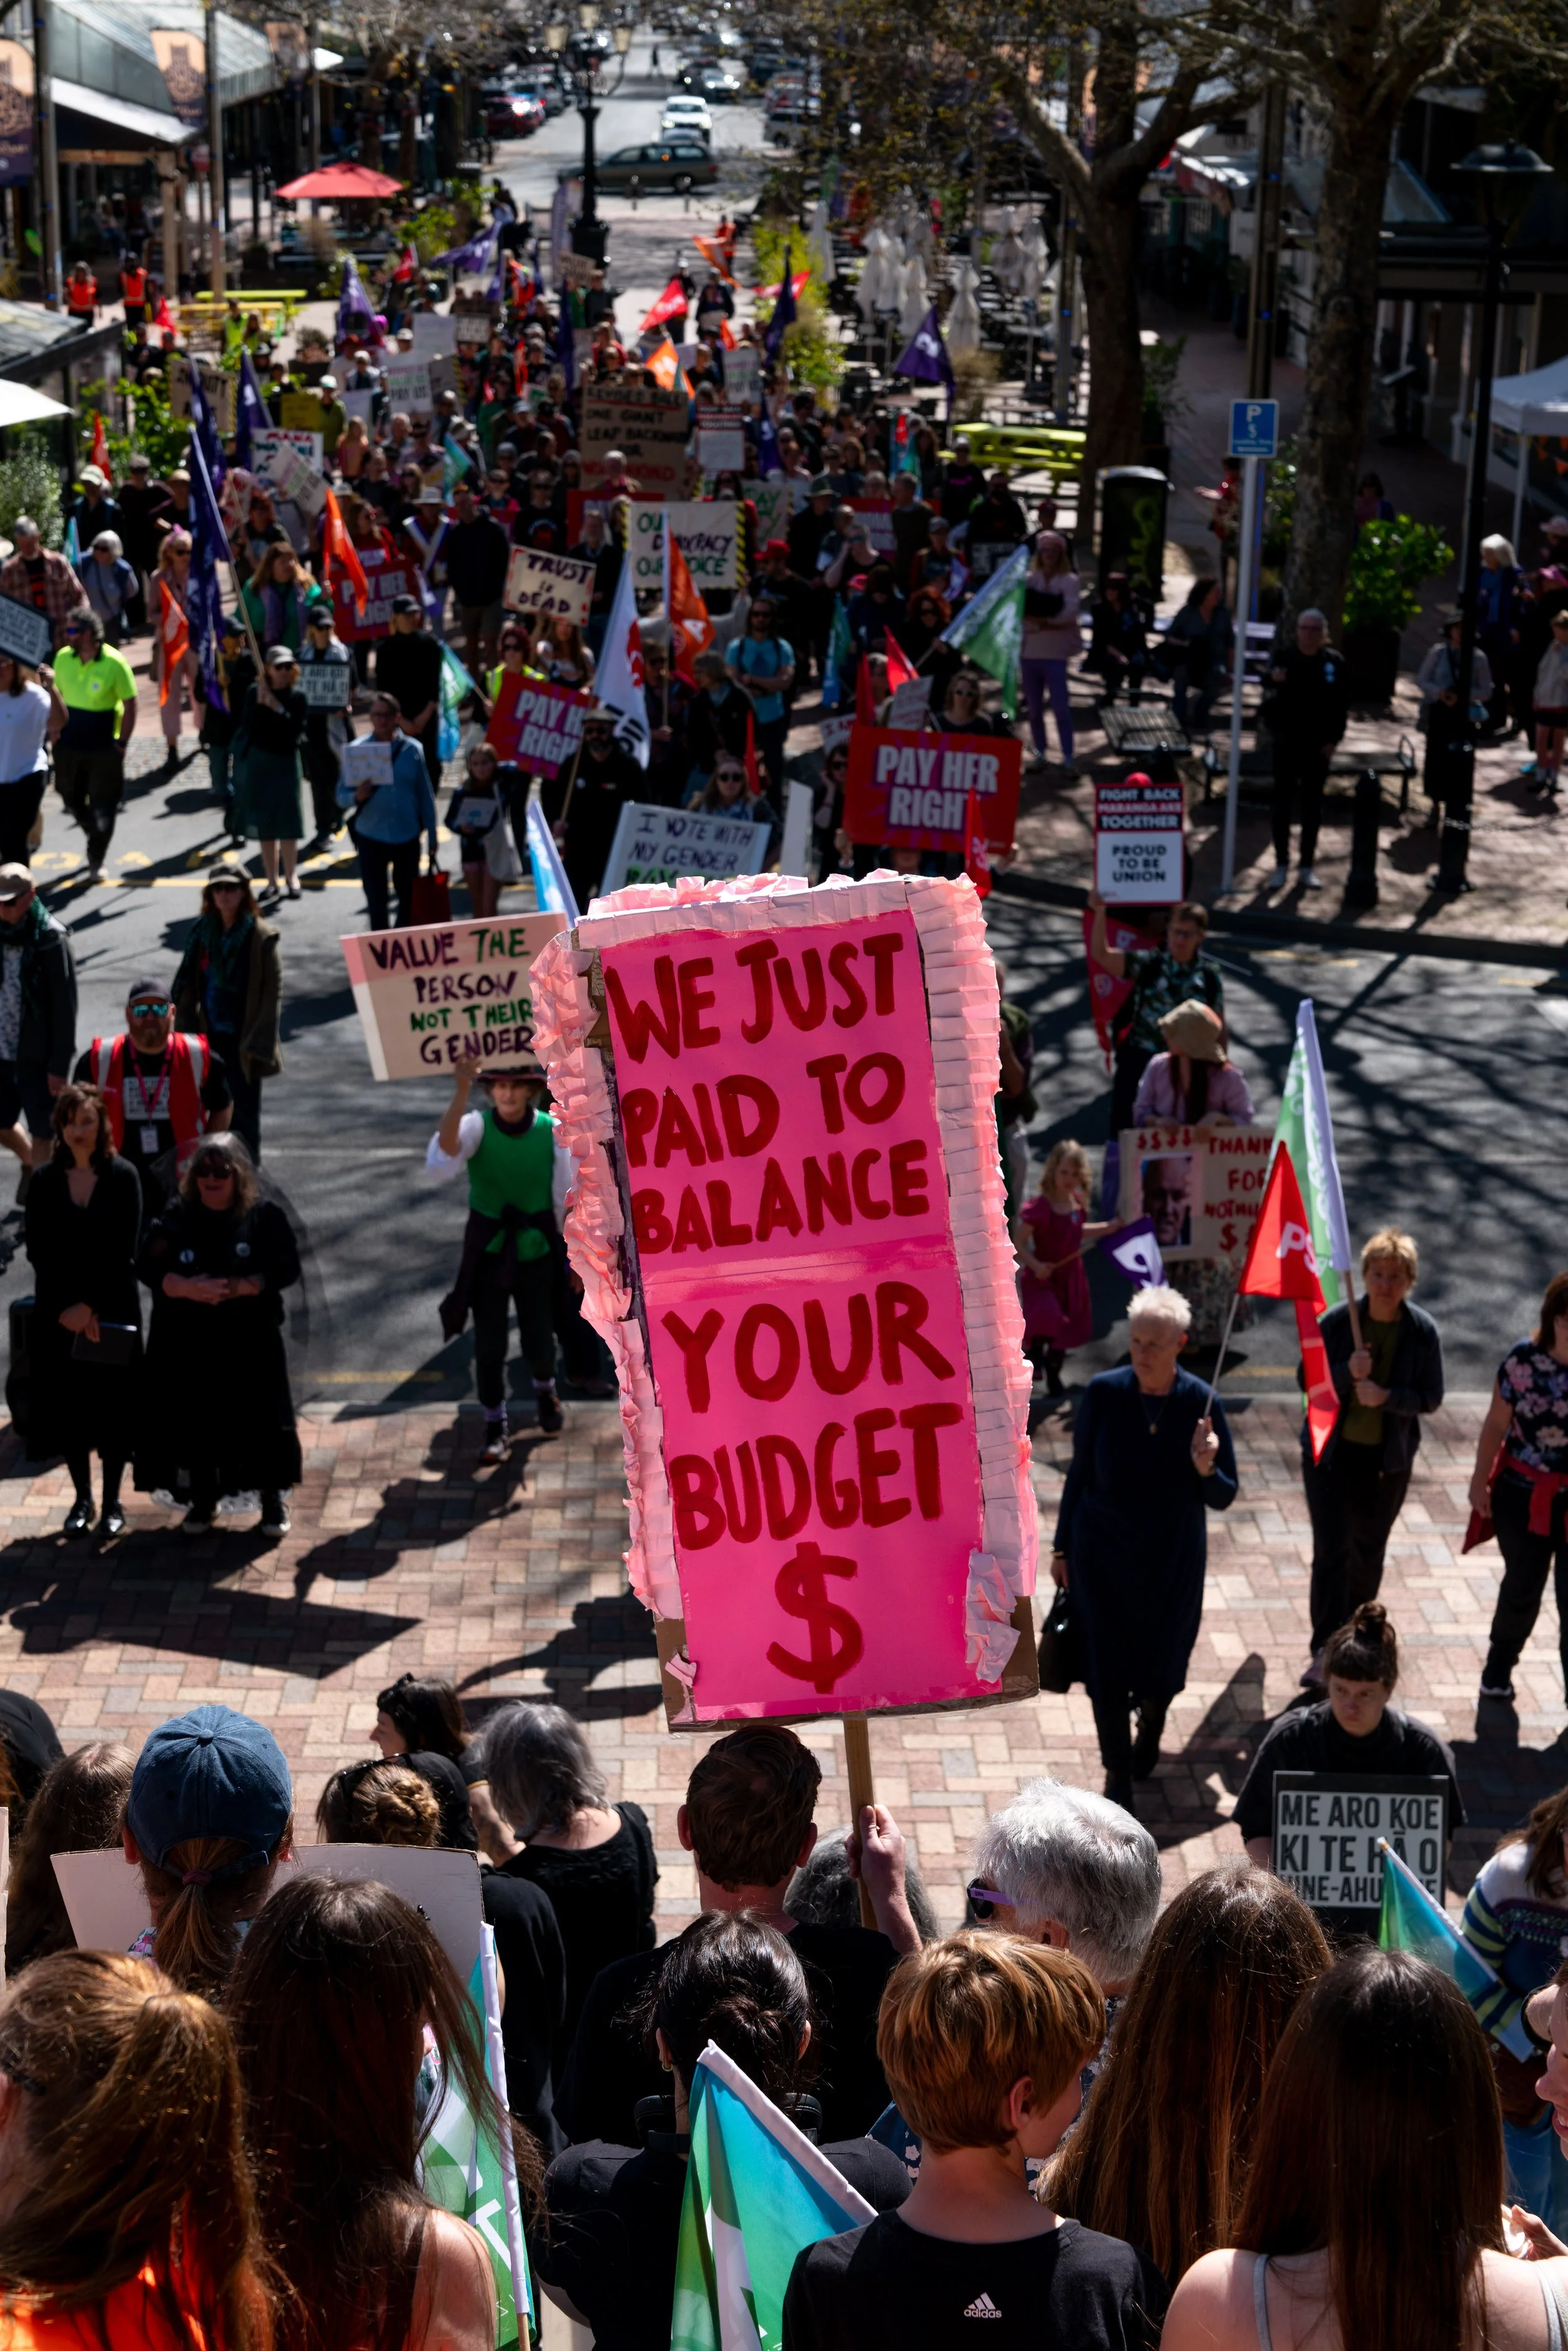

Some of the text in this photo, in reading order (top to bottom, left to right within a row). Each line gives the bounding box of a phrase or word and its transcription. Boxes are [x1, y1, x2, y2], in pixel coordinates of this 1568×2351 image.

[586, 408, 612, 420] ONE
[1246, 405, 1262, 423] P
[527, 555, 591, 583] TRUST
[519, 592, 570, 613] DEAD
[514, 689, 566, 729] PAY
[517, 722, 581, 766] RIGH
[876, 744, 1001, 793] PAY HER
[1099, 788, 1180, 801] FIGHT BACK
[637, 813, 755, 846] I VOTE WITH
[1101, 815, 1179, 829] TOGETHER
[628, 839, 739, 873] MY GENDER
[1113, 845, 1166, 856] PROUD
[1120, 858, 1159, 869] TO BE
[1113, 871, 1166, 883] UNION
[369, 928, 531, 969] VALUE THE
[415, 970, 519, 1003] PERSON
[603, 932, 904, 1064] WE JUST
[411, 999, 533, 1031] NOT THEIR
[421, 1026, 536, 1065] GENDER
[620, 1052, 906, 1168] PAID TO
[630, 1139, 931, 1255] BALANCE
[661, 1281, 955, 1414] YOUR
[669, 1402, 964, 1551] BUDGET
[766, 1541, 865, 1694] $
[1281, 1795, 1439, 1830] ME ARO KOE
[1281, 1834, 1309, 1872] KI
[1320, 1835, 1357, 1872] TE
[1420, 1838, 1438, 1875] O
[963, 2308, 1002, 2318] adidas
